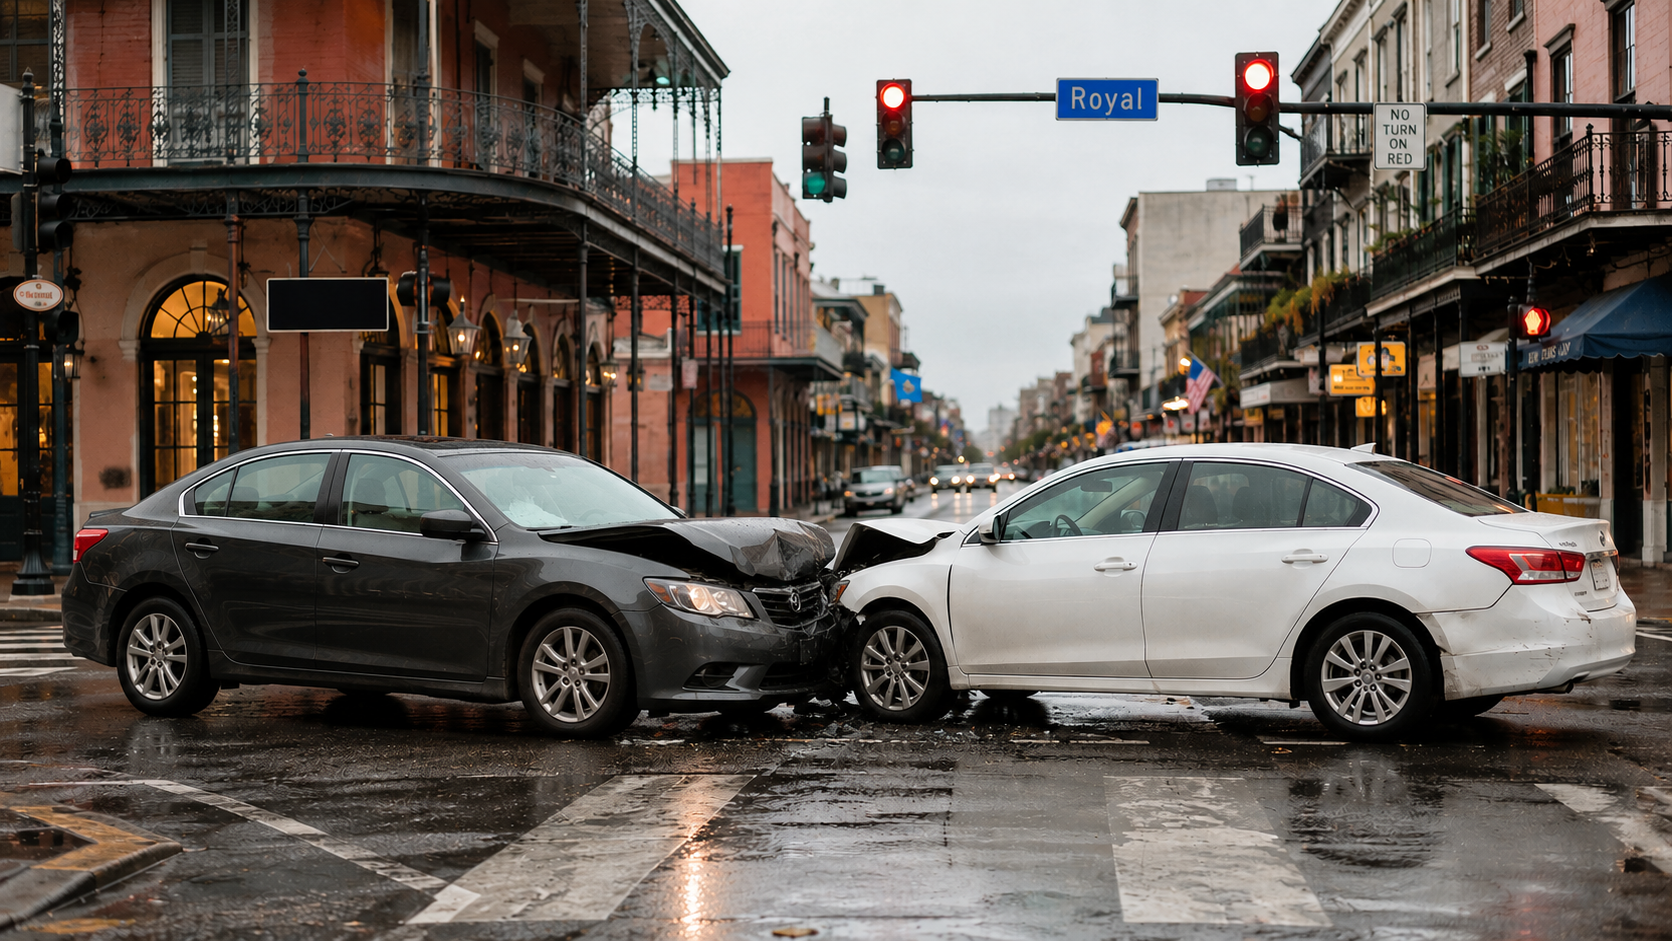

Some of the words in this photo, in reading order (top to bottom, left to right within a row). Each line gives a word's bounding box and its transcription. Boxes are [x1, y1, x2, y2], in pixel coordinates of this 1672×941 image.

[1071, 86, 1142, 116] Royal
[1390, 108, 1410, 121] NO
[1382, 124, 1417, 136] TURN
[1389, 138, 1407, 150] ON
[1387, 152, 1413, 165] RED
